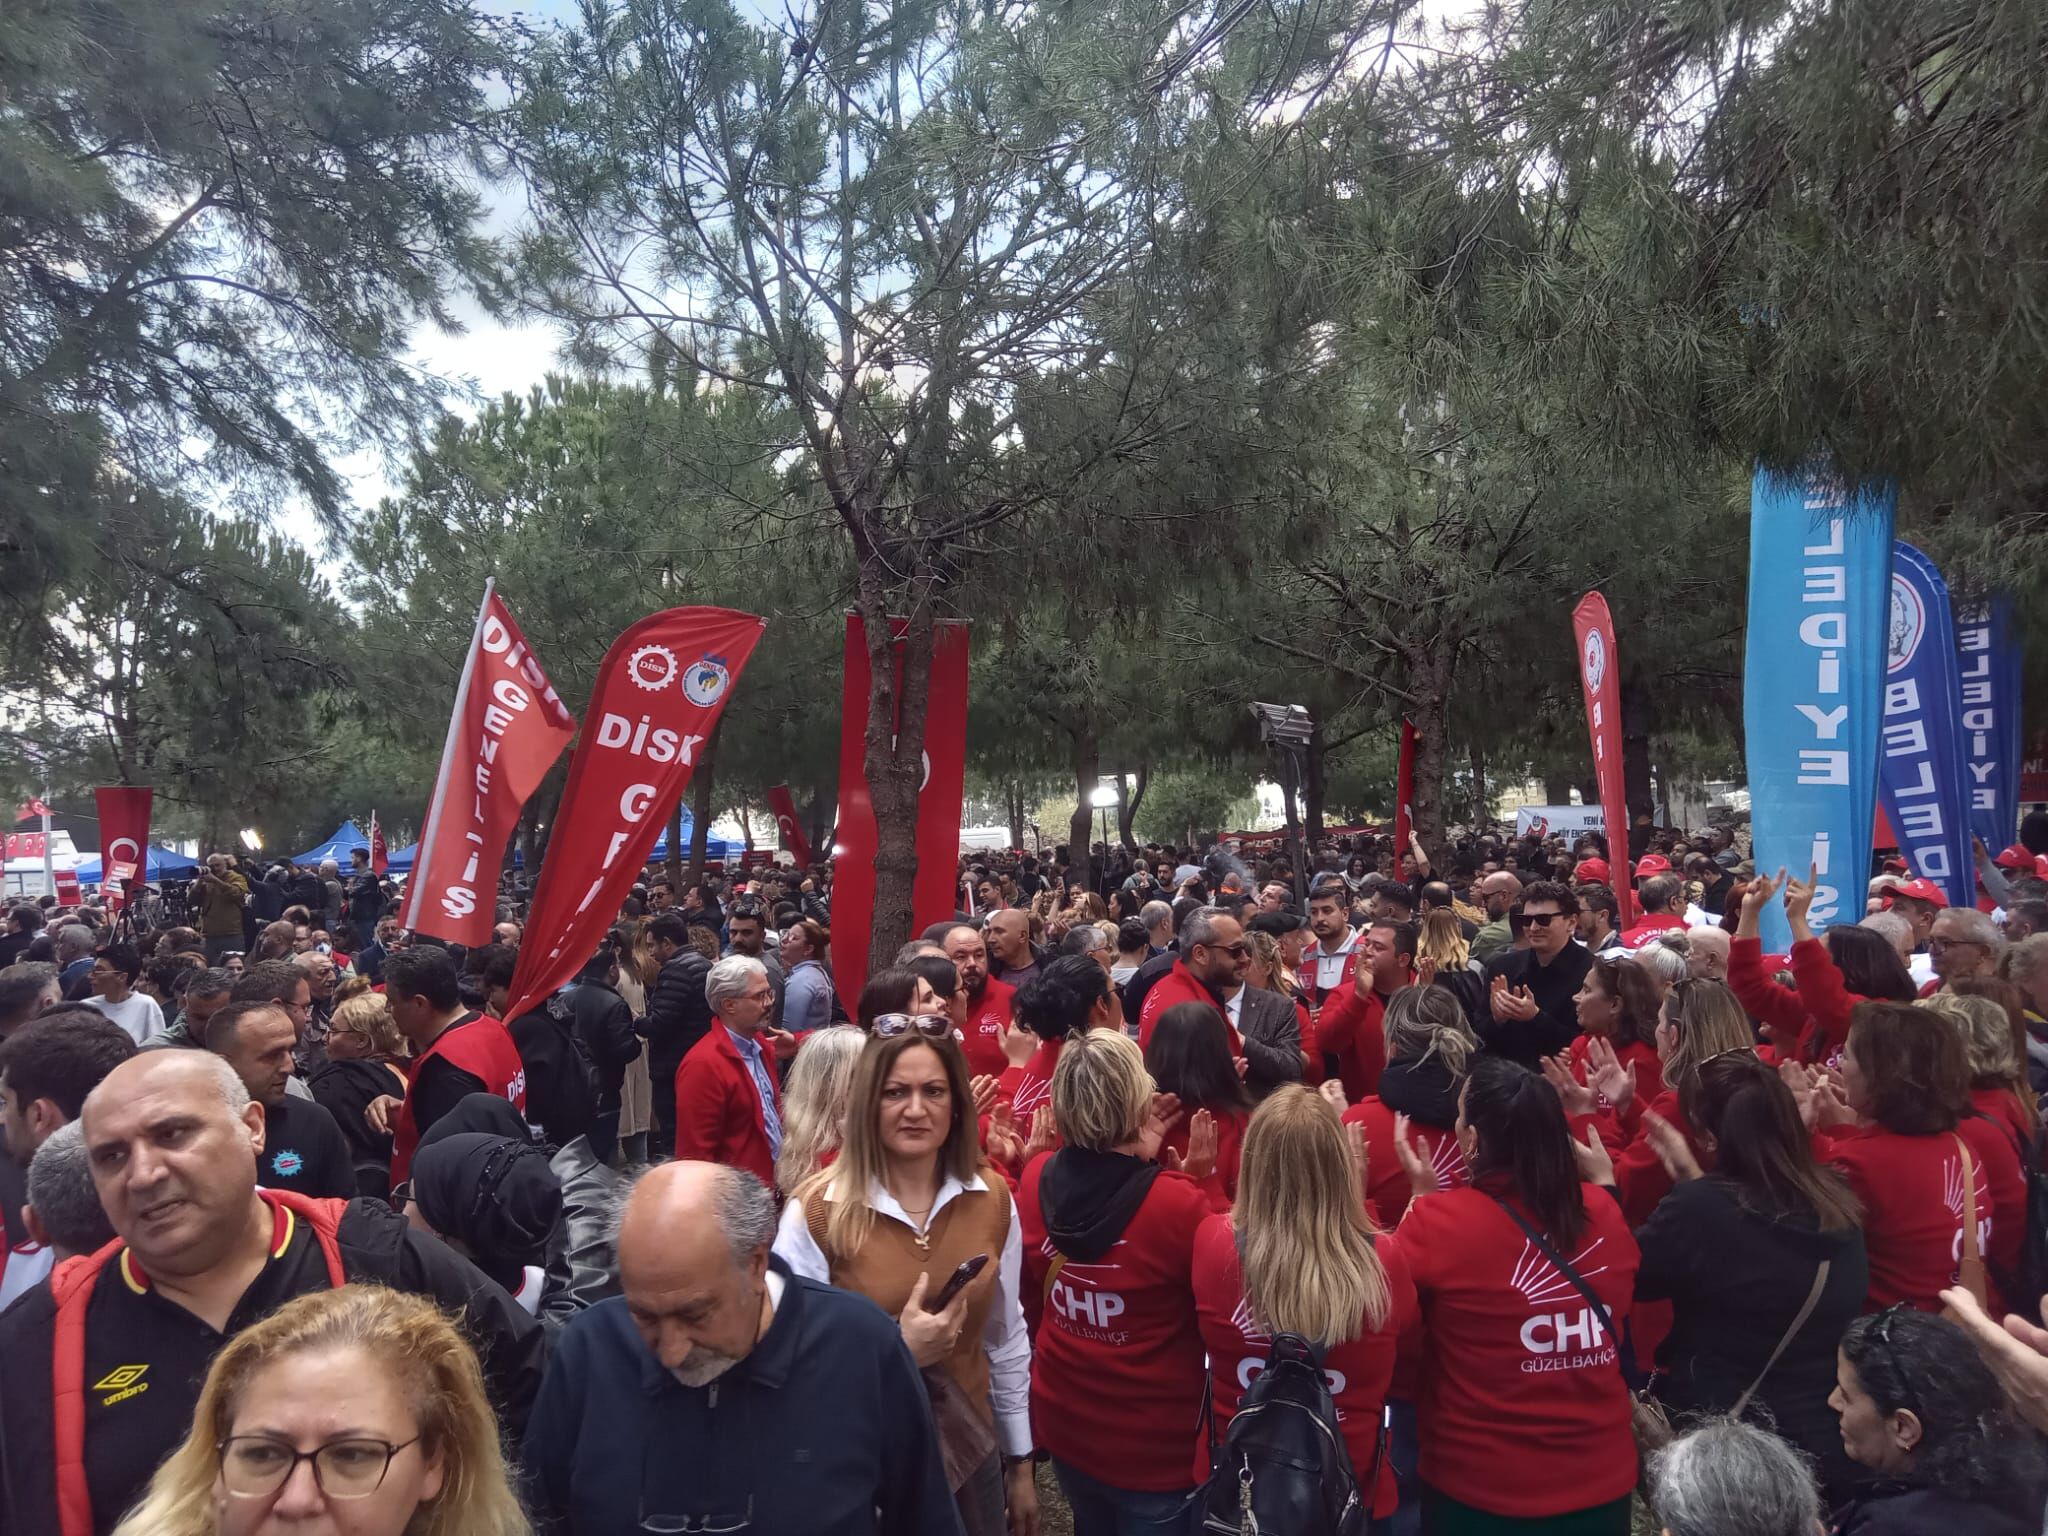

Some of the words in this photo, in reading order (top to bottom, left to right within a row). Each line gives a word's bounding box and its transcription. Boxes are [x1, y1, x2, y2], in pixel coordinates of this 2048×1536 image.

[639, 658, 667, 675] DİSK
[597, 712, 704, 767] DİSK
[1050, 1279, 1125, 1328] CHP
[1519, 1304, 1613, 1354] CHP
[103, 1382, 149, 1406] umbro
[1236, 1356, 1346, 1395] CP
